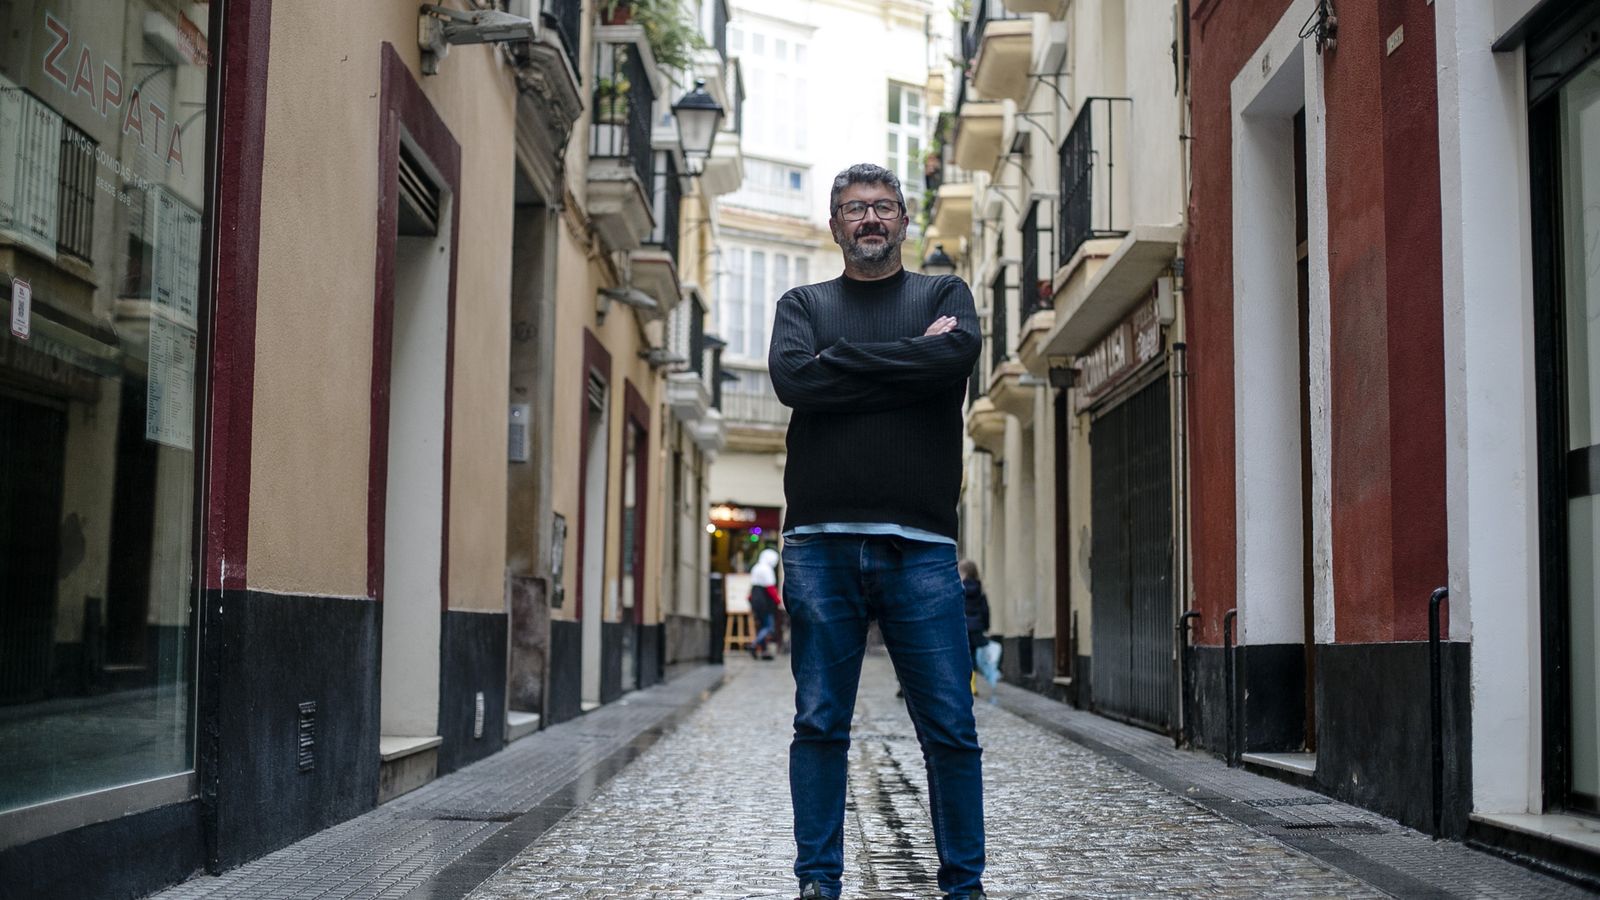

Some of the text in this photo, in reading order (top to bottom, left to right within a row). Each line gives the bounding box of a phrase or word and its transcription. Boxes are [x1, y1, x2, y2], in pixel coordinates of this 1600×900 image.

[43, 10, 185, 176] ZAPATA
[66, 126, 92, 155] VINOS
[95, 147, 131, 181] COMIDAS
